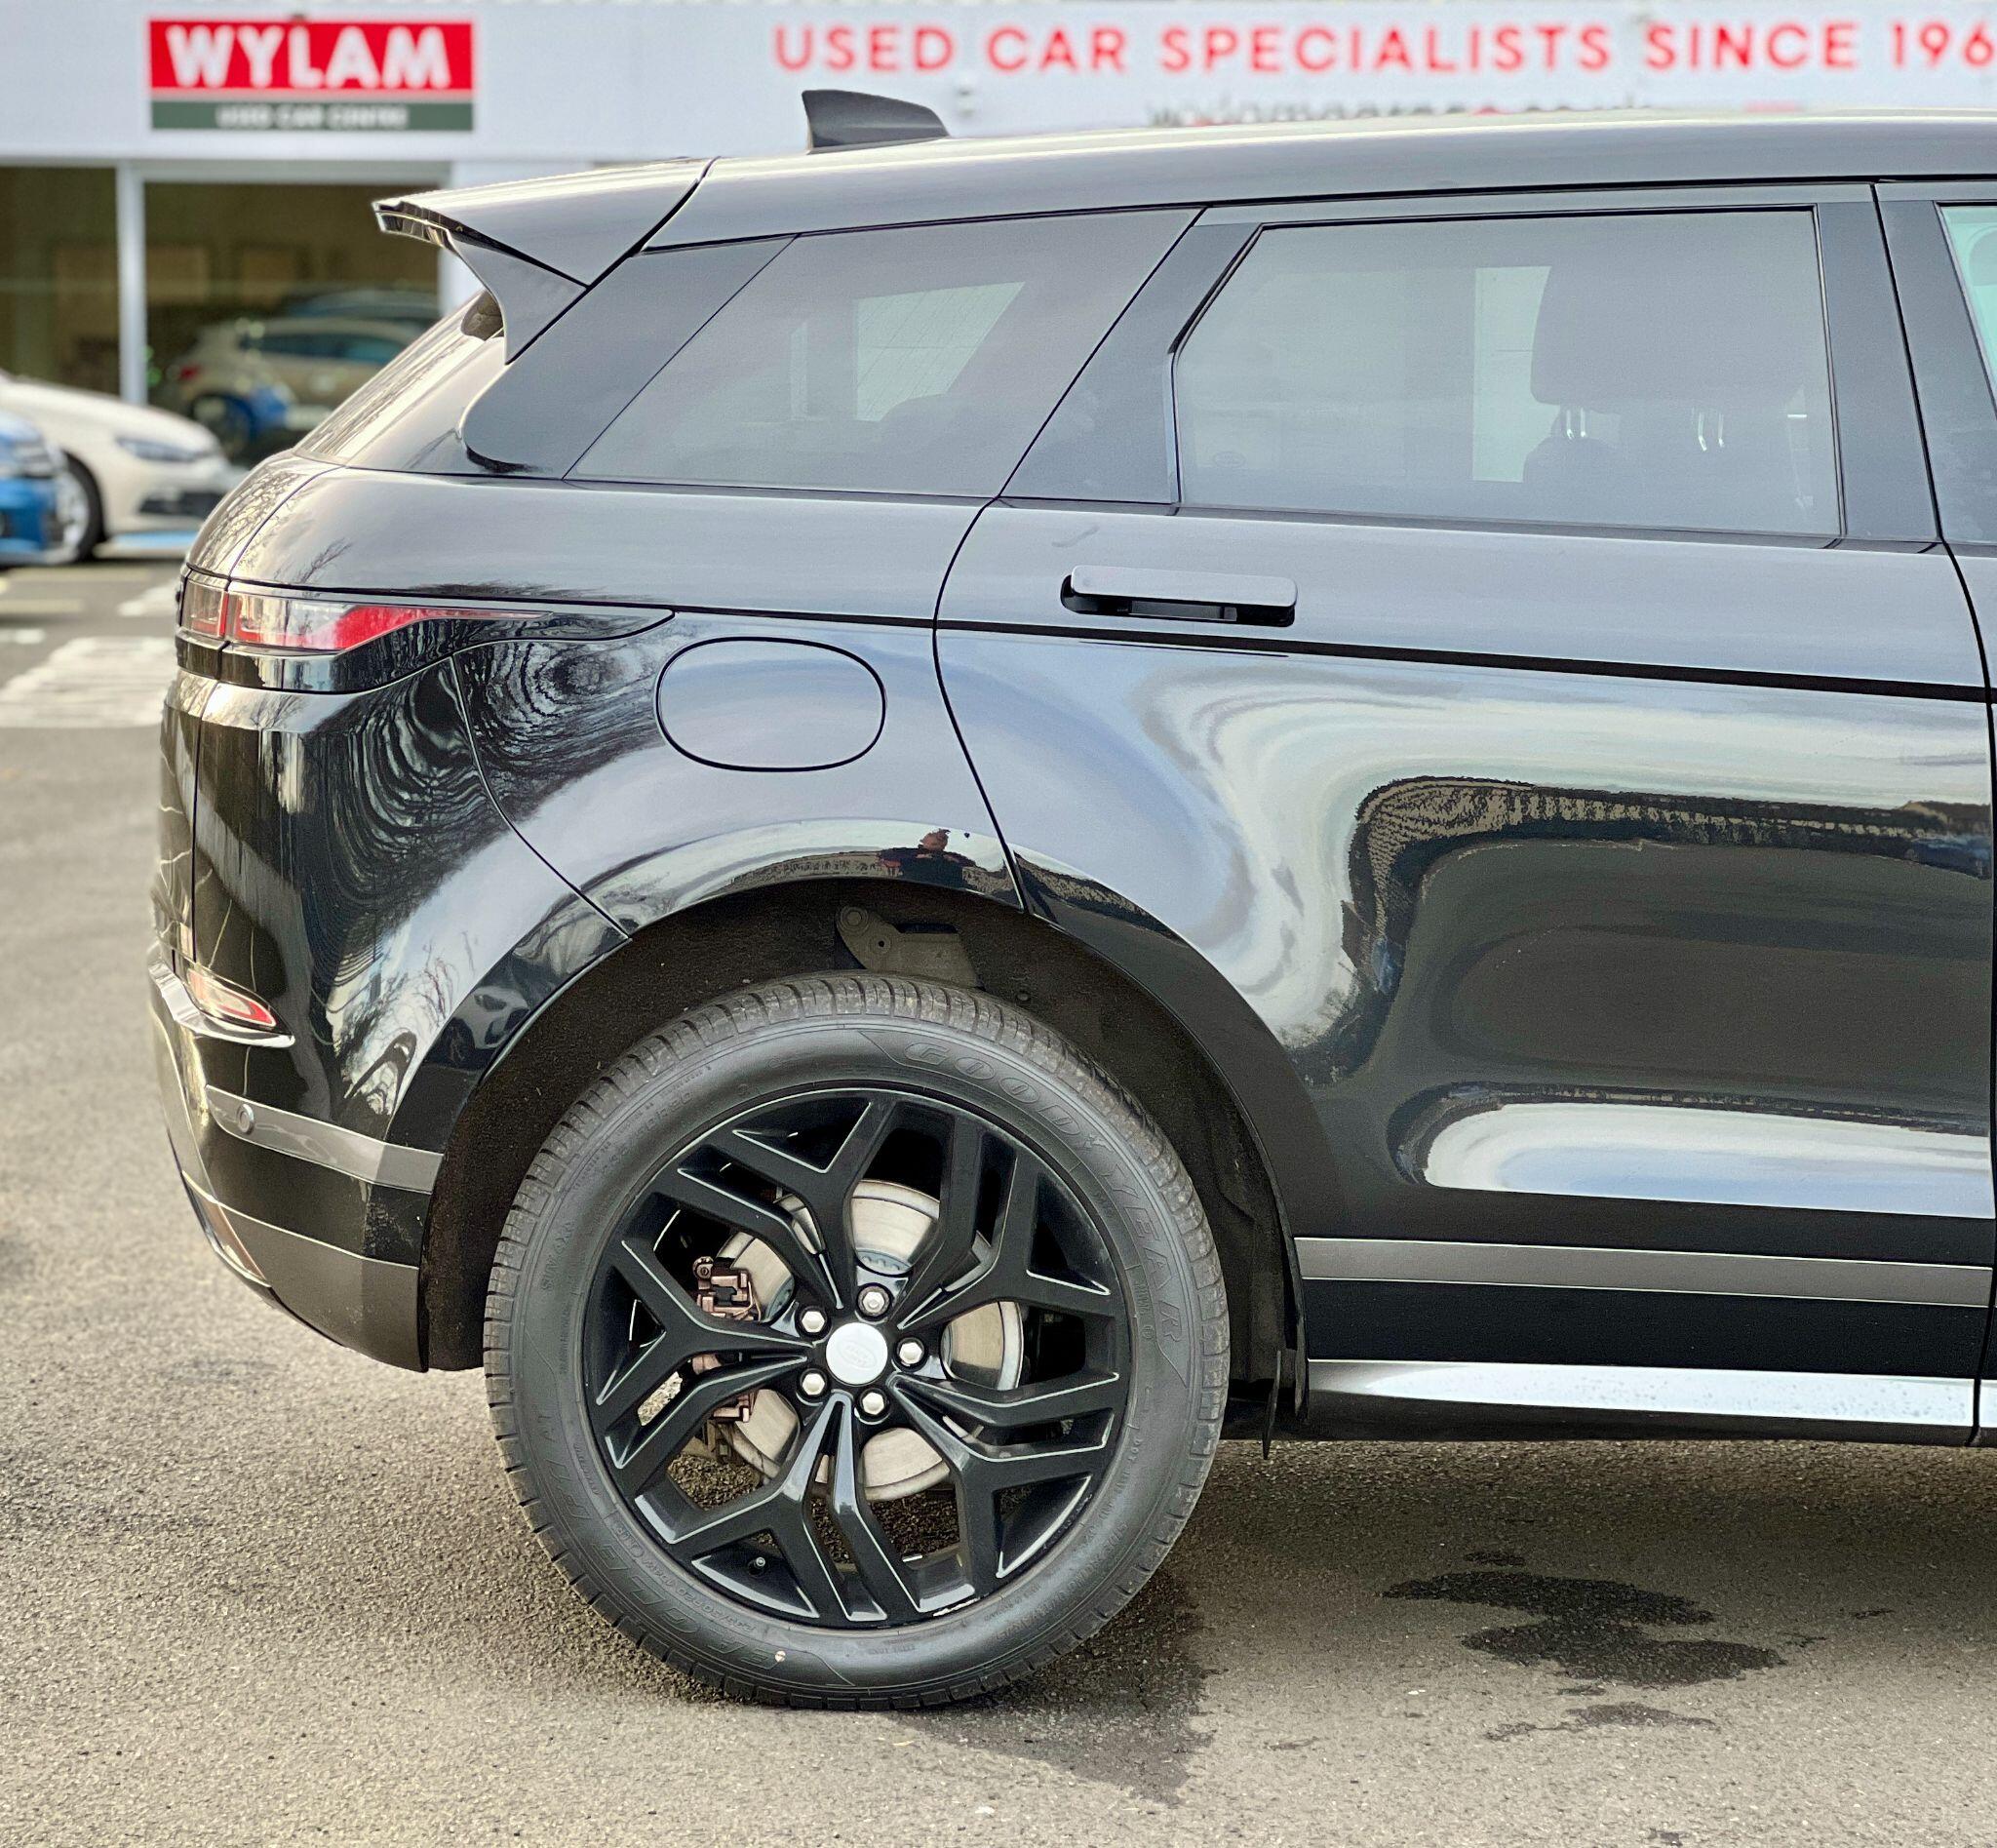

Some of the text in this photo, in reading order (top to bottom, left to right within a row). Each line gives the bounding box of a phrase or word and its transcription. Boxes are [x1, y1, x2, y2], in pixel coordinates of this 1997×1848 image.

[165, 24, 451, 89] WYLAM
[773, 25, 955, 72] USED
[986, 25, 1127, 72] CAR
[1159, 25, 1611, 72] SPECIALISTS
[1646, 23, 1858, 70] SINCE
